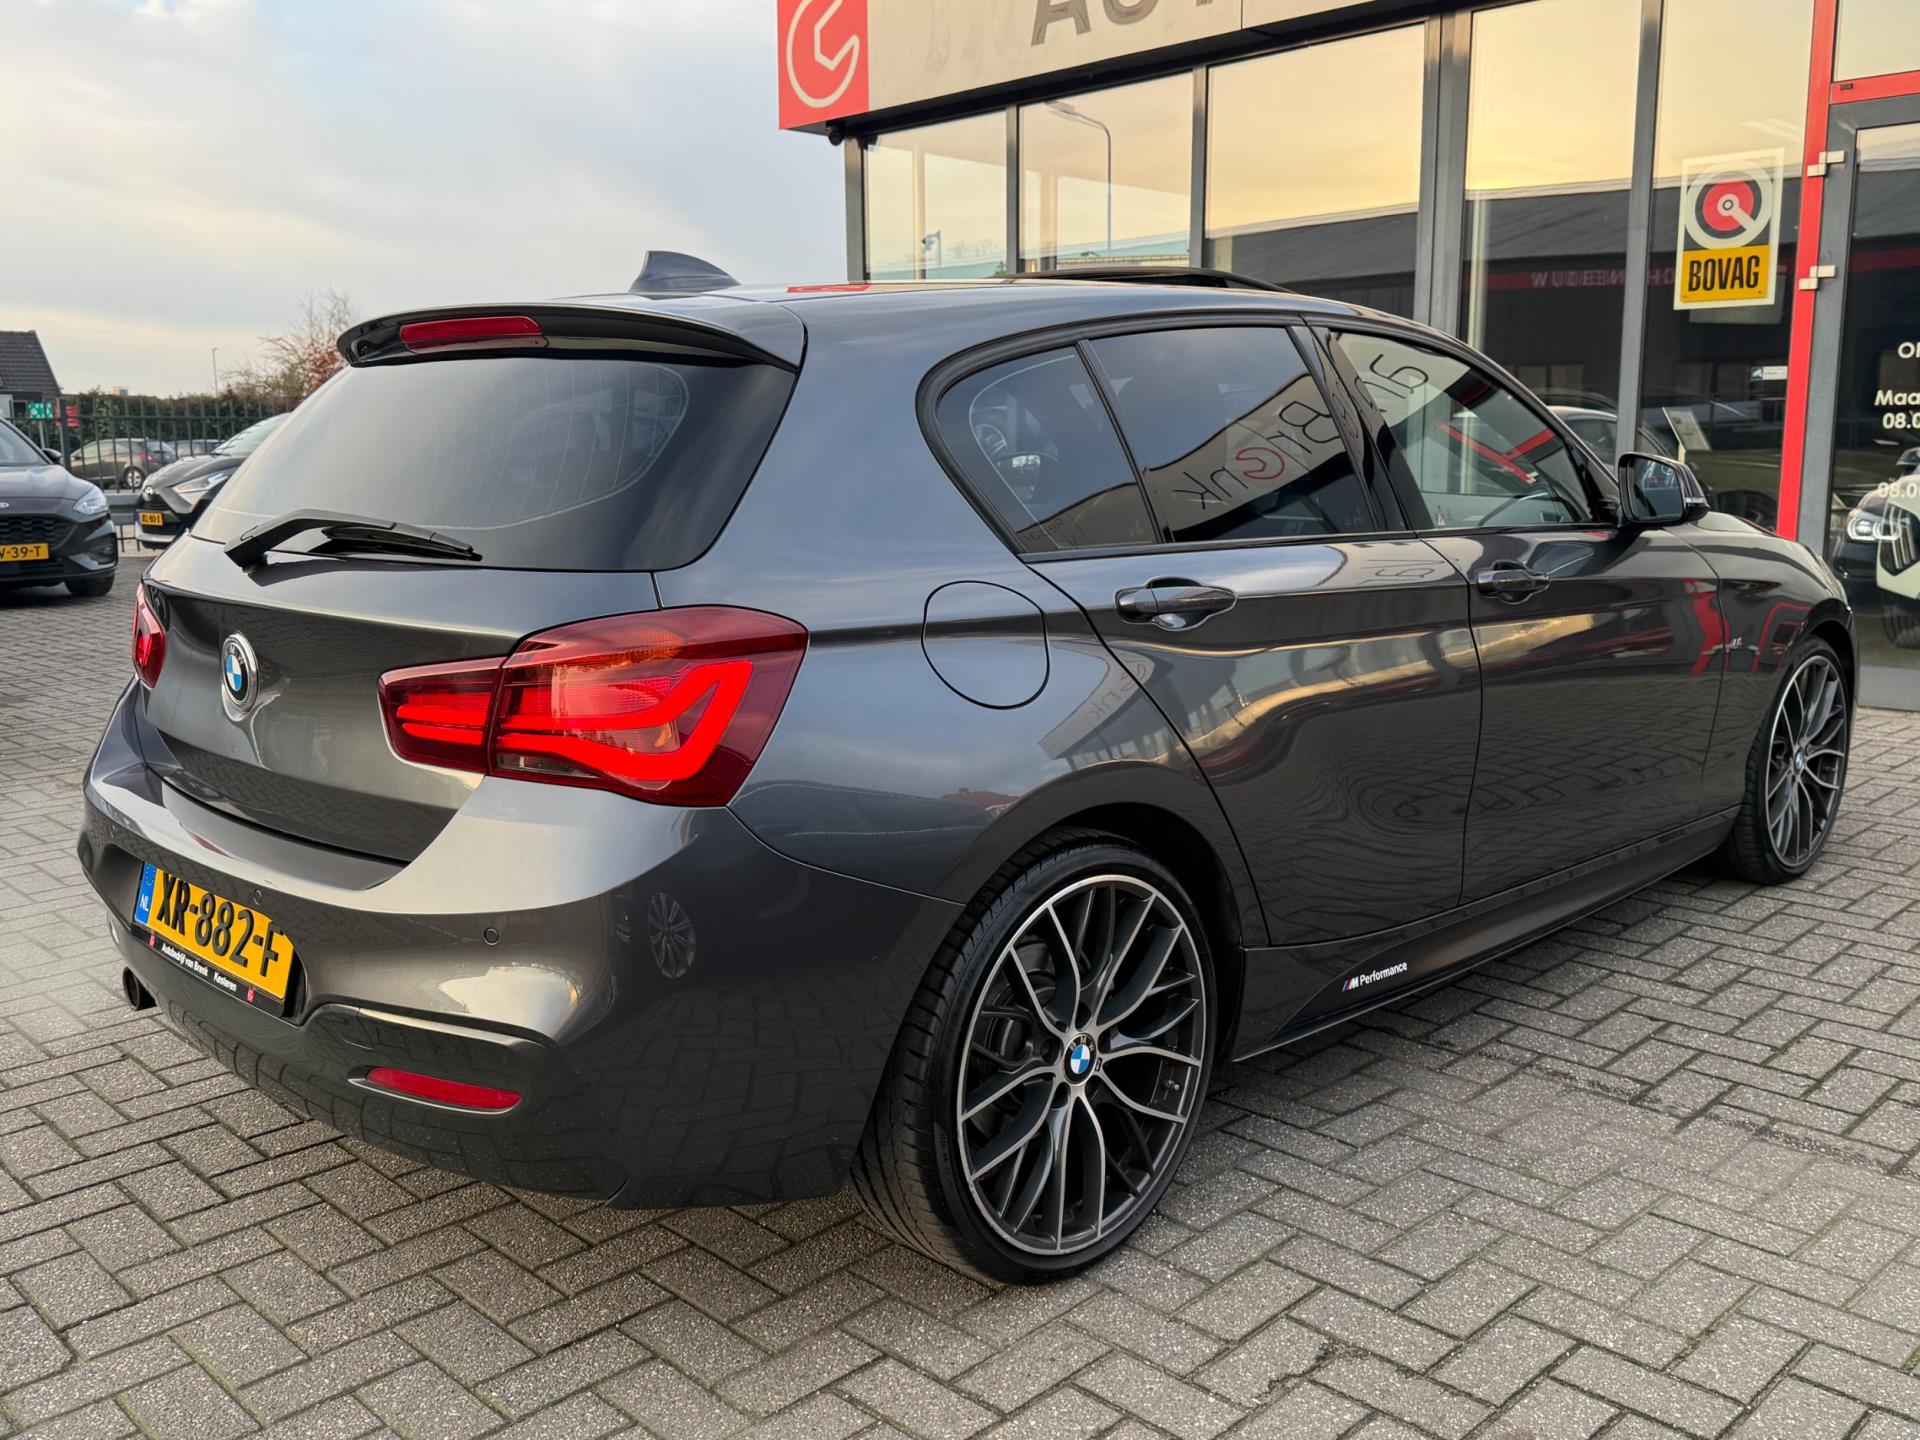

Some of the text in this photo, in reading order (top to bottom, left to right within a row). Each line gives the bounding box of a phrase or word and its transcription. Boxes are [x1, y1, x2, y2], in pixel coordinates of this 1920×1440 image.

[1688, 255, 1760, 292] BOVAG
[1898, 342, 1920, 359] O
[139, 894, 149, 912] NL
[156, 872, 284, 977] XR-882-F
[185, 957, 194, 968] van
[1359, 961, 1408, 987] Performance
[1069, 1036, 1095, 1052] BMW
